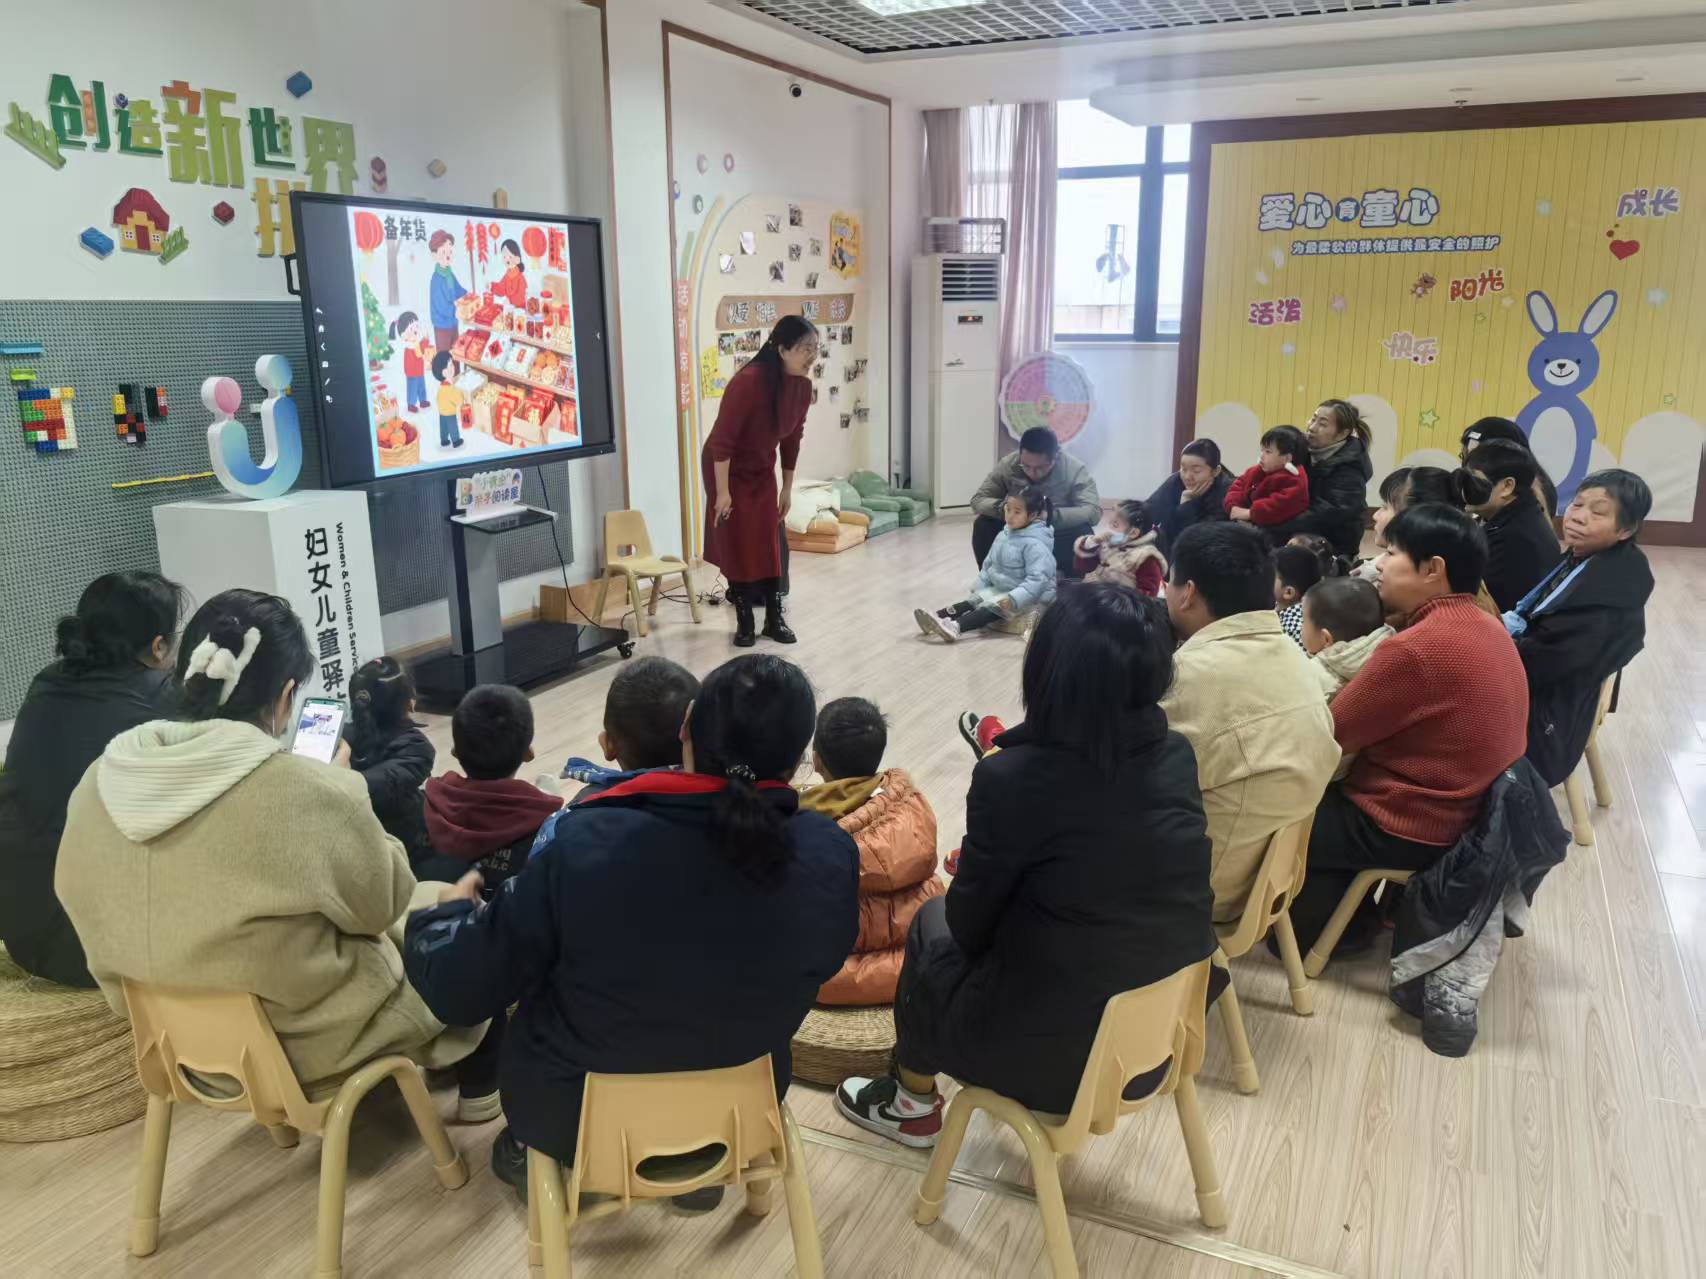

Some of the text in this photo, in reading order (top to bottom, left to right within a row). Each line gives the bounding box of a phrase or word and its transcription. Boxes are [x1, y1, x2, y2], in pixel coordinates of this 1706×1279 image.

[47, 73, 358, 193] 创造新世界
[1616, 188, 1680, 218] 成长
[384, 215, 427, 241] 备年货
[1291, 235, 1501, 255] 为最柔软的群体提供最安全的照护
[1449, 268, 1506, 302] 阳光
[1248, 298, 1301, 326] 活泼
[1383, 333, 1438, 363] 快乐
[335, 522, 346, 568] Women
[341, 570, 349, 580] &
[305, 527, 346, 699] 妇女儿童驿
[343, 582, 353, 630] Children
